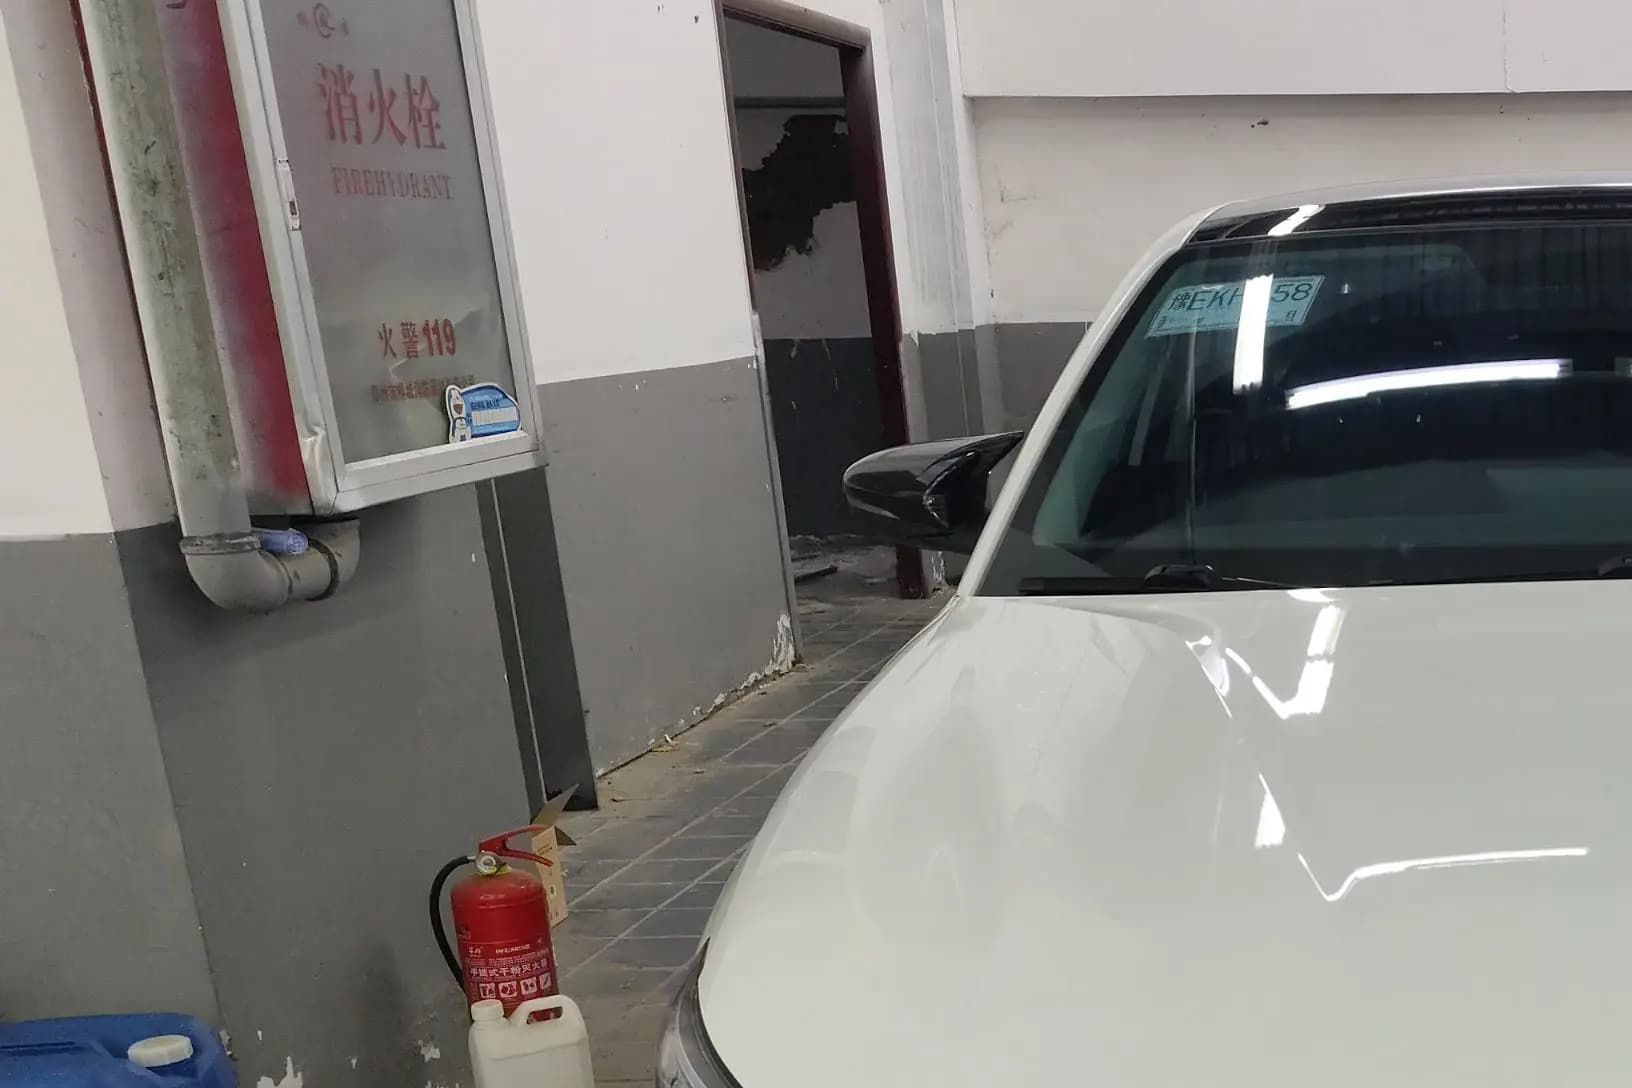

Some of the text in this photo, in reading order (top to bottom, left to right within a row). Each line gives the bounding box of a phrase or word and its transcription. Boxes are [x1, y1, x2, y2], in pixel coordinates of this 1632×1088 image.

[316, 62, 447, 150] 消火栓
[1167, 283, 1313, 312] 豫EKH58
